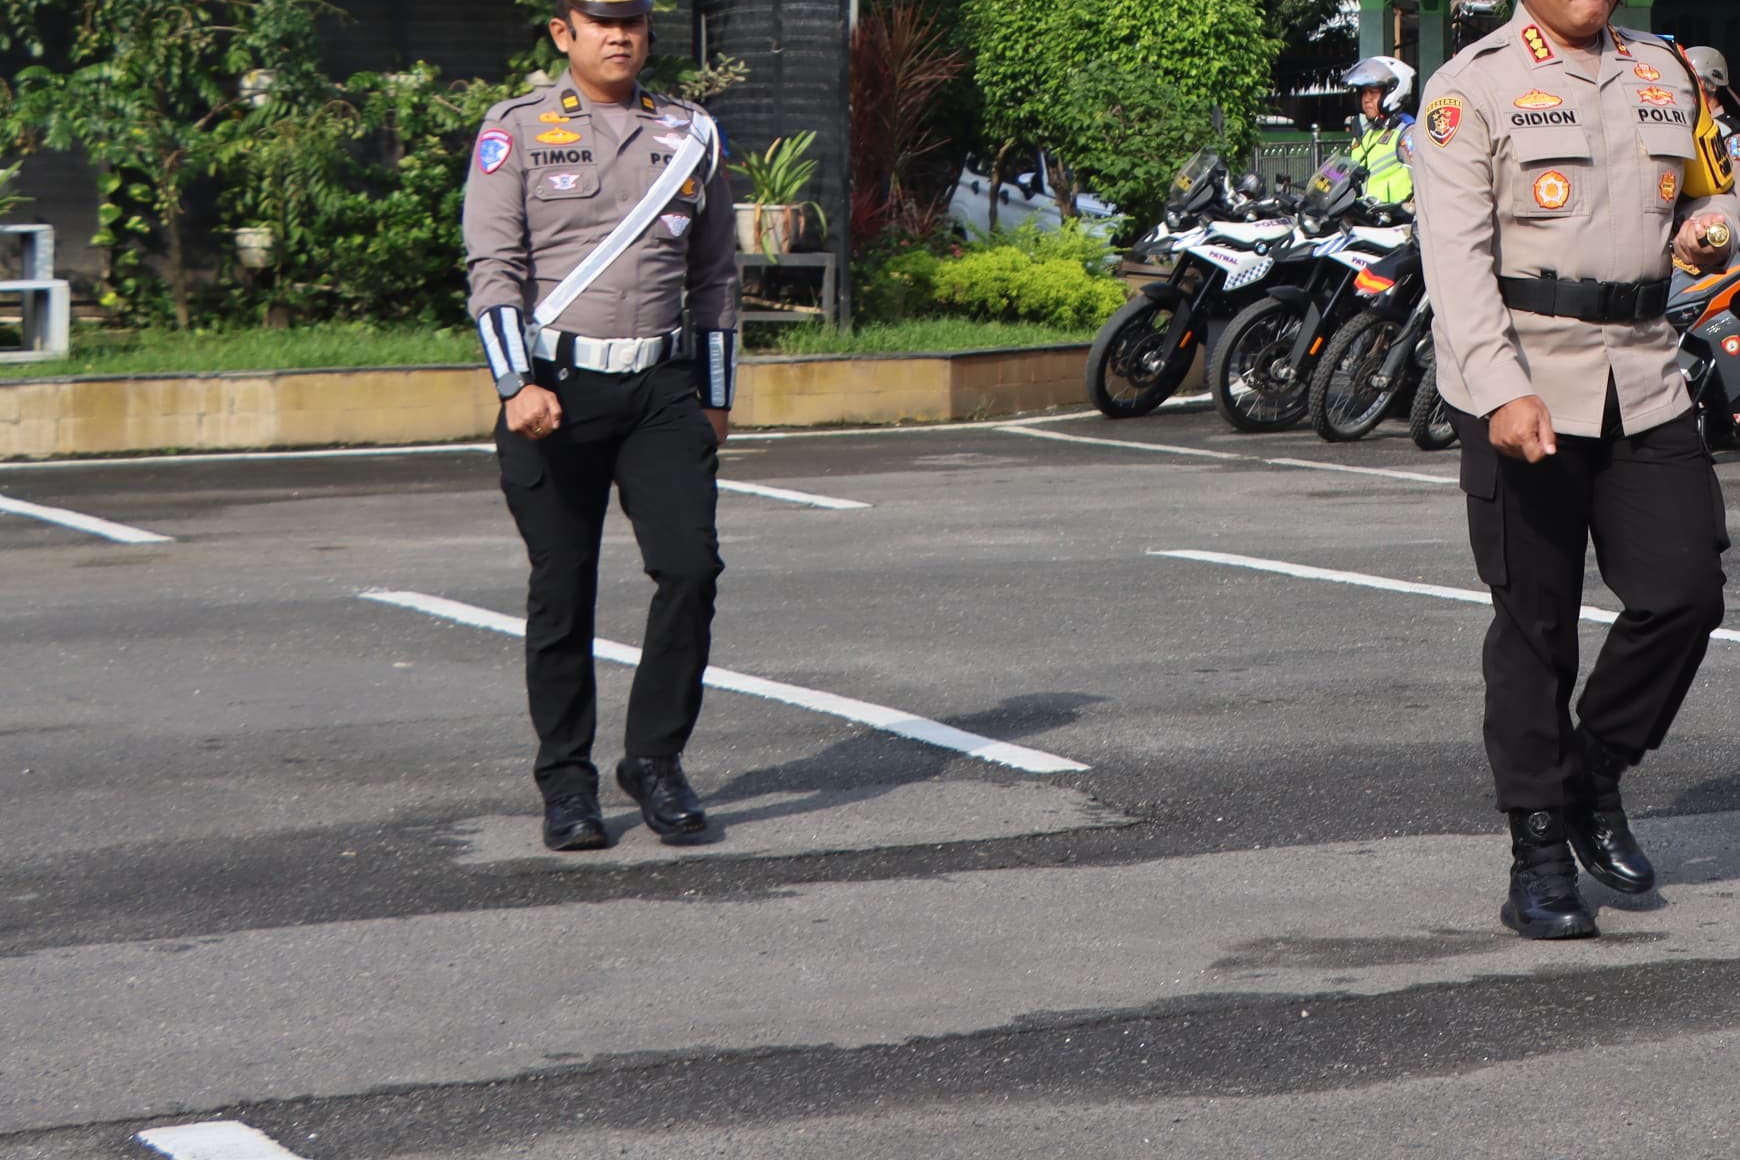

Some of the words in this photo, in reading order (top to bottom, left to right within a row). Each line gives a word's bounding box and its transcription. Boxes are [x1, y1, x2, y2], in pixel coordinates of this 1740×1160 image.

[1511, 110, 1576, 126] GIDION
[1638, 108, 1687, 125] POLRI
[531, 150, 593, 166] TIMOR
[651, 152, 675, 165] PO
